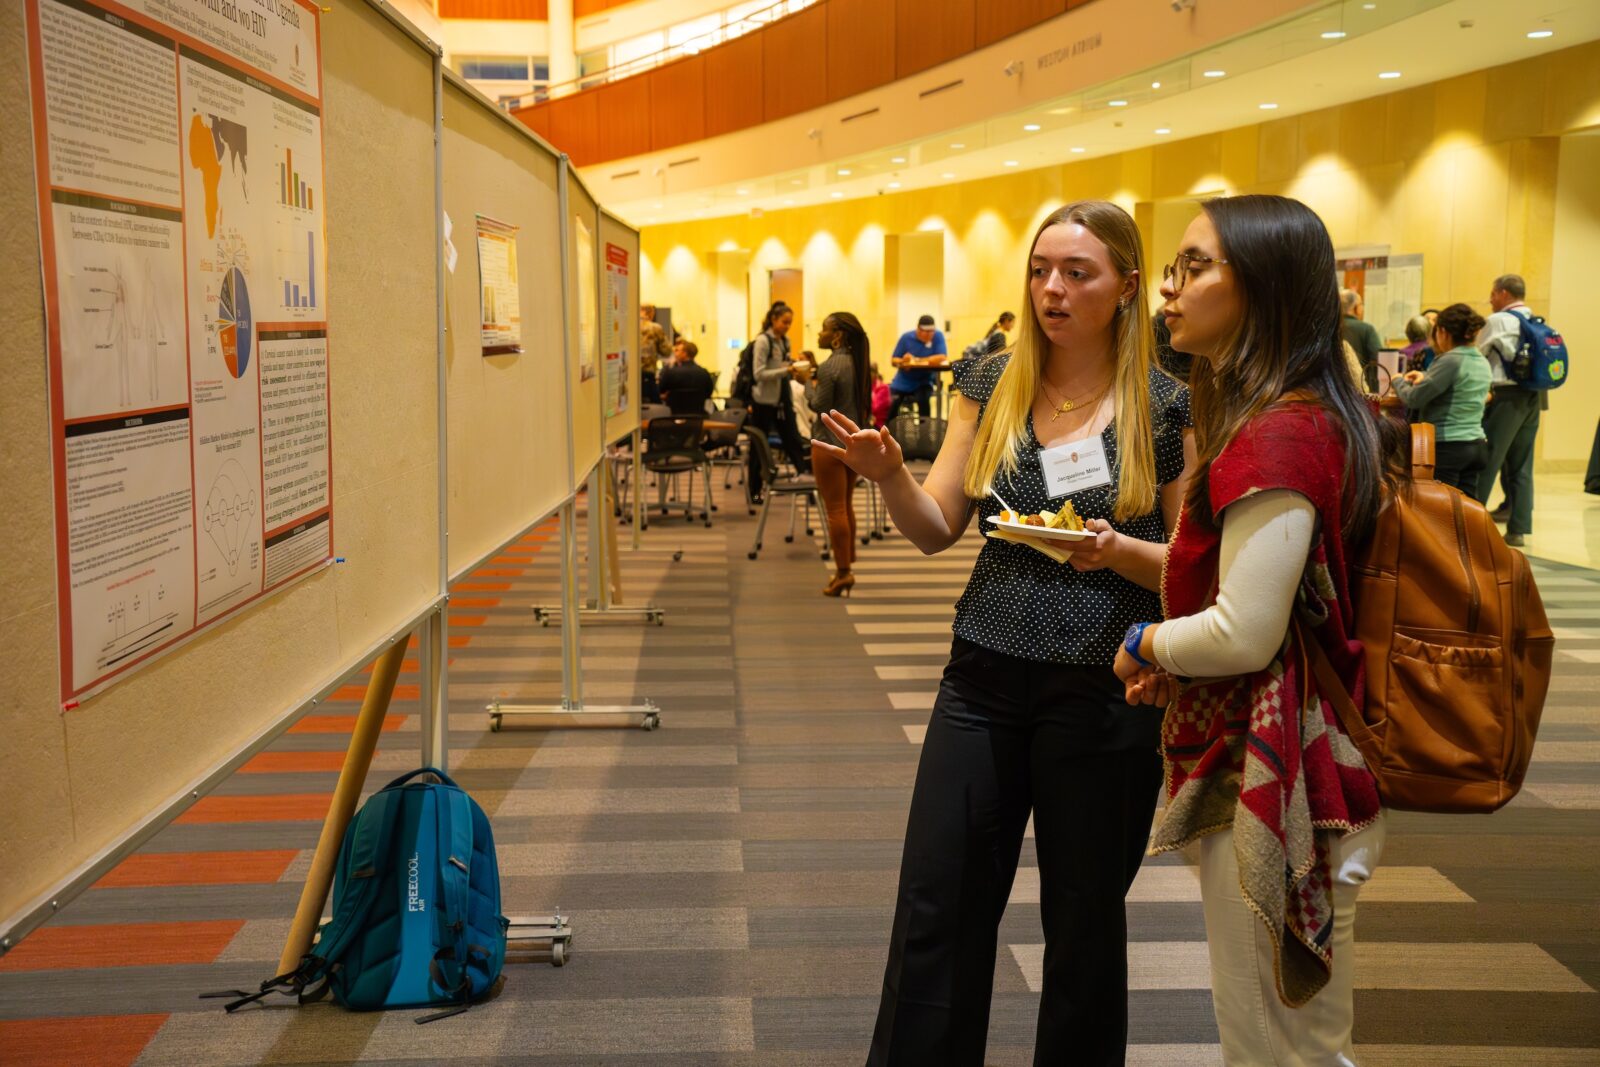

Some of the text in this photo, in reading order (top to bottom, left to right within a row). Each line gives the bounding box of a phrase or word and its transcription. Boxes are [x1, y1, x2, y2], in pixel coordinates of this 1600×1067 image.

[221, 0, 238, 23] and
[251, 10, 267, 38] HIV
[1057, 470, 1086, 482] Jacqueline
[1085, 466, 1101, 474] Miller
